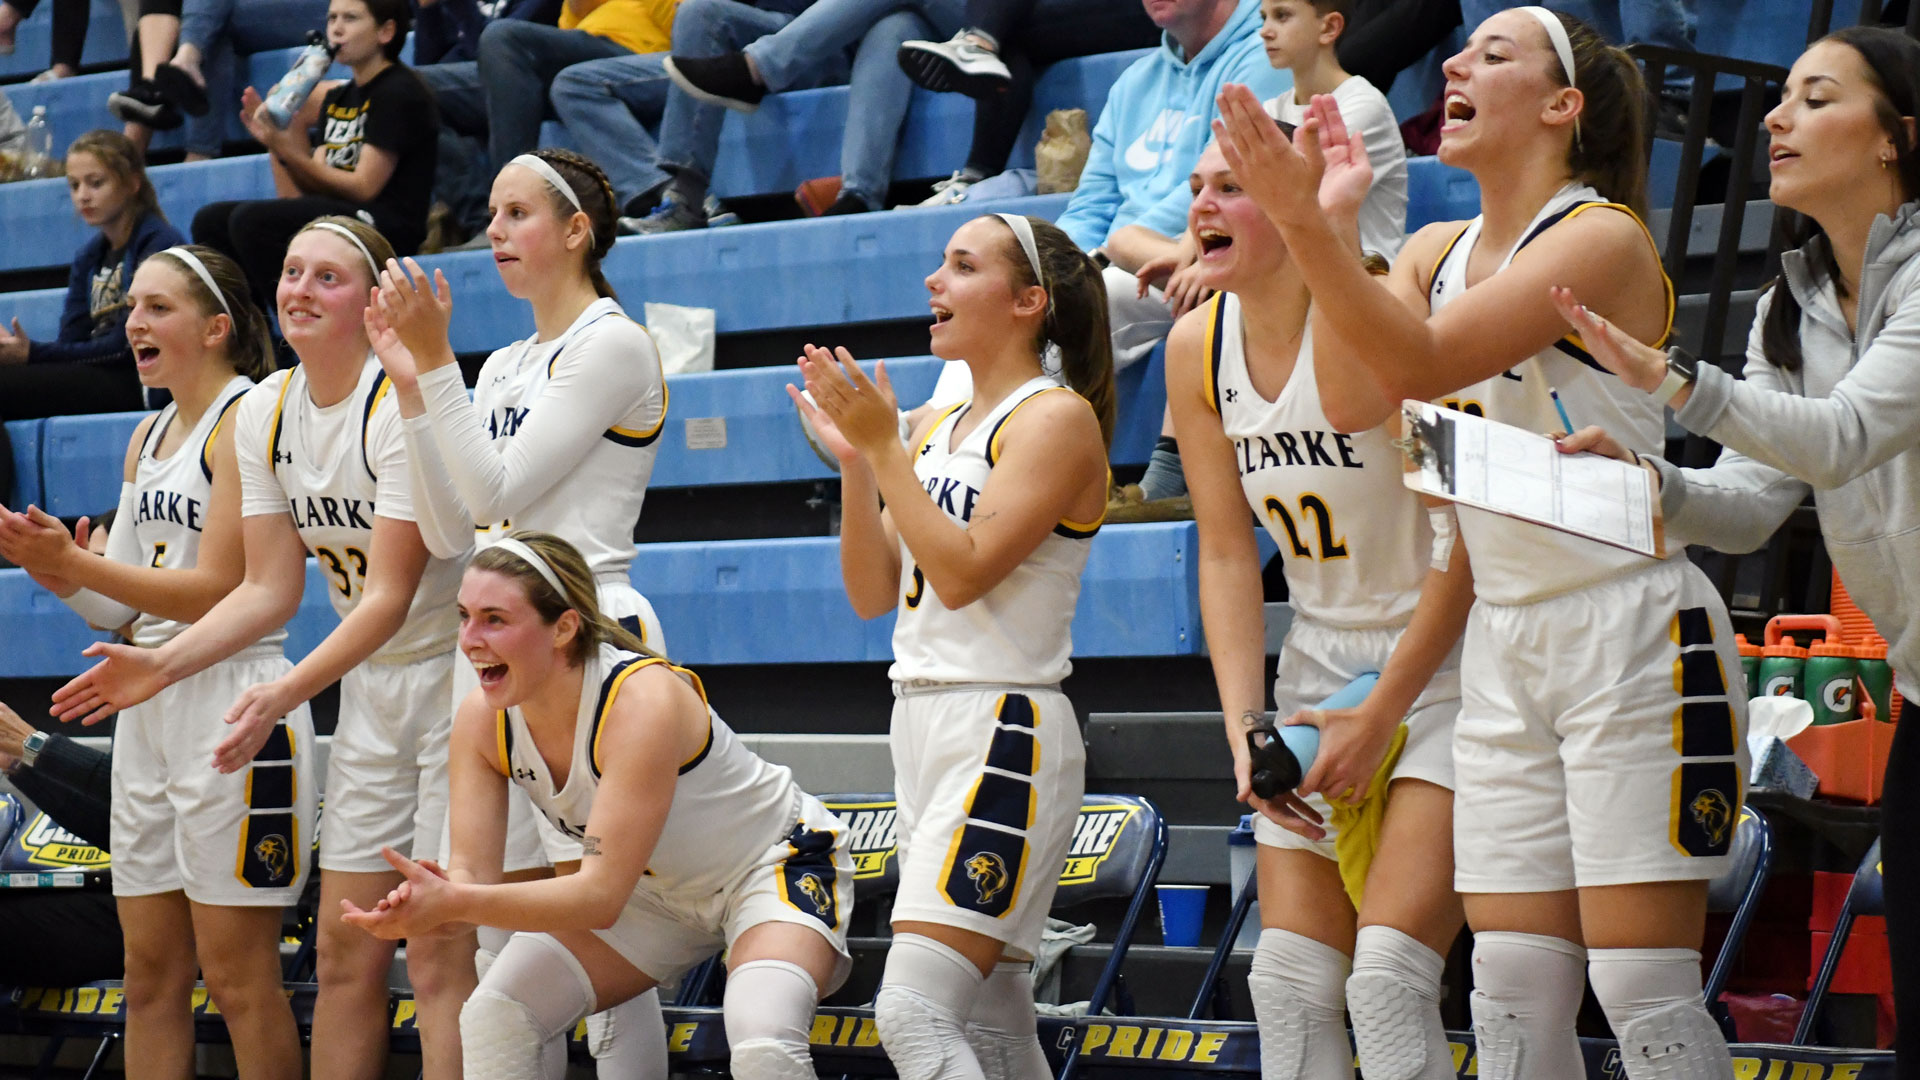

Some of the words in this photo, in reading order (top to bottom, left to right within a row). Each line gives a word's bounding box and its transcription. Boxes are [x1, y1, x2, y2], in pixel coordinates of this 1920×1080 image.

[133, 489, 203, 533] ARKE
[290, 496, 375, 530] LARK
[1262, 491, 1350, 562] 22
[315, 545, 368, 600] 33
[1823, 678, 1852, 712] G
[808, 1014, 881, 1046] RID
[1079, 1024, 1230, 1064] PRIDE
[1732, 1057, 1864, 1080] RIDE
